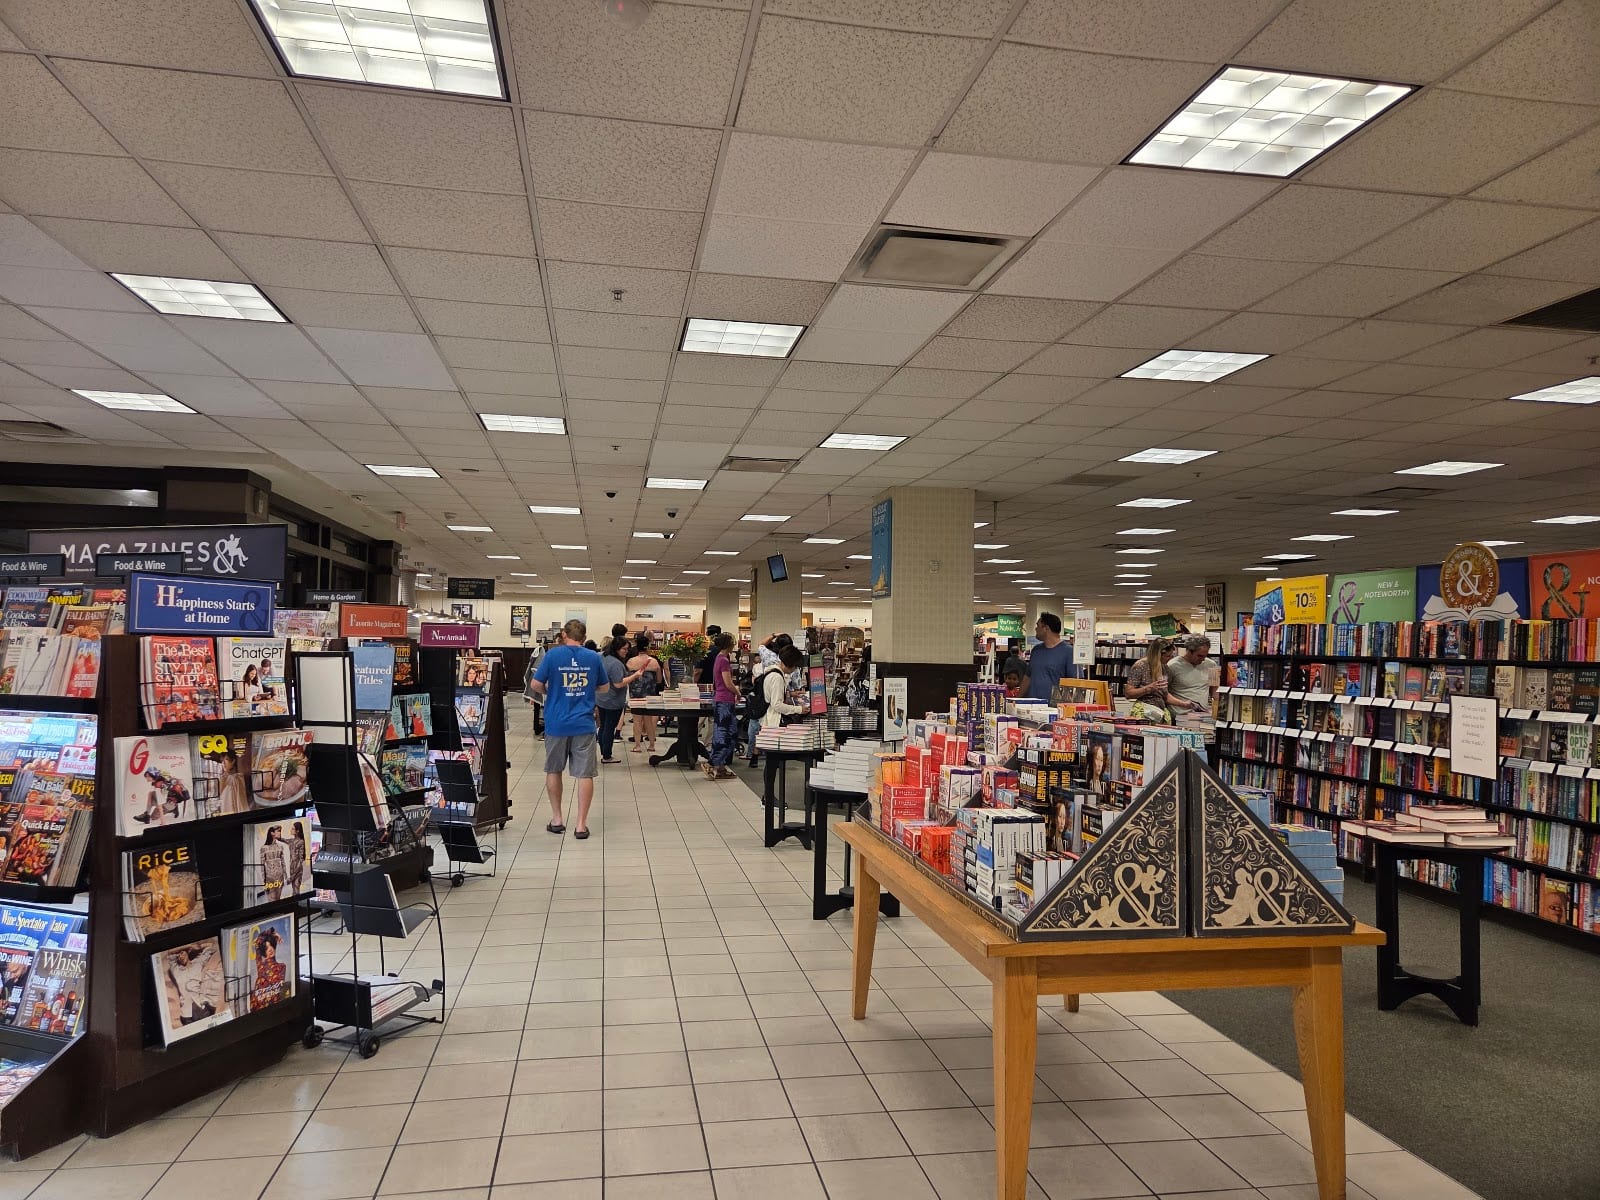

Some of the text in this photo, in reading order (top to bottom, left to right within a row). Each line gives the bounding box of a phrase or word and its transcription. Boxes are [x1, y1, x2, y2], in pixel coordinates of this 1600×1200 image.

[2, 561, 48, 571] Food & Wine
[114, 560, 166, 571] Food & Wine
[1377, 581, 1394, 589] NEW
[155, 584, 256, 611] Happiness Starts
[313, 593, 330, 601] Home
[336, 593, 356, 601] Garden
[1364, 589, 1410, 599] NOTEWORTHY
[6, 610, 36, 620] Cookies
[66, 611, 83, 620] FALL
[184, 612, 230, 624] at Home
[349, 613, 401, 629] Favorite Magazines
[431, 629, 446, 641] New
[154, 643, 211, 657] The Best
[231, 646, 285, 659] ChatGPT
[155, 661, 204, 675] STYLE
[358, 674, 384, 685] Titles
[561, 672, 589, 688] 125
[1569, 724, 1590, 737] ALAN
[198, 734, 228, 755] GQ
[1569, 736, 1589, 748] OPTS
[17, 748, 60, 760] FALL RECIPES
[1571, 747, 1586, 760] OUT
[22, 819, 65, 834] Quick & Easy
[2, 909, 49, 931] Wine Spectator
